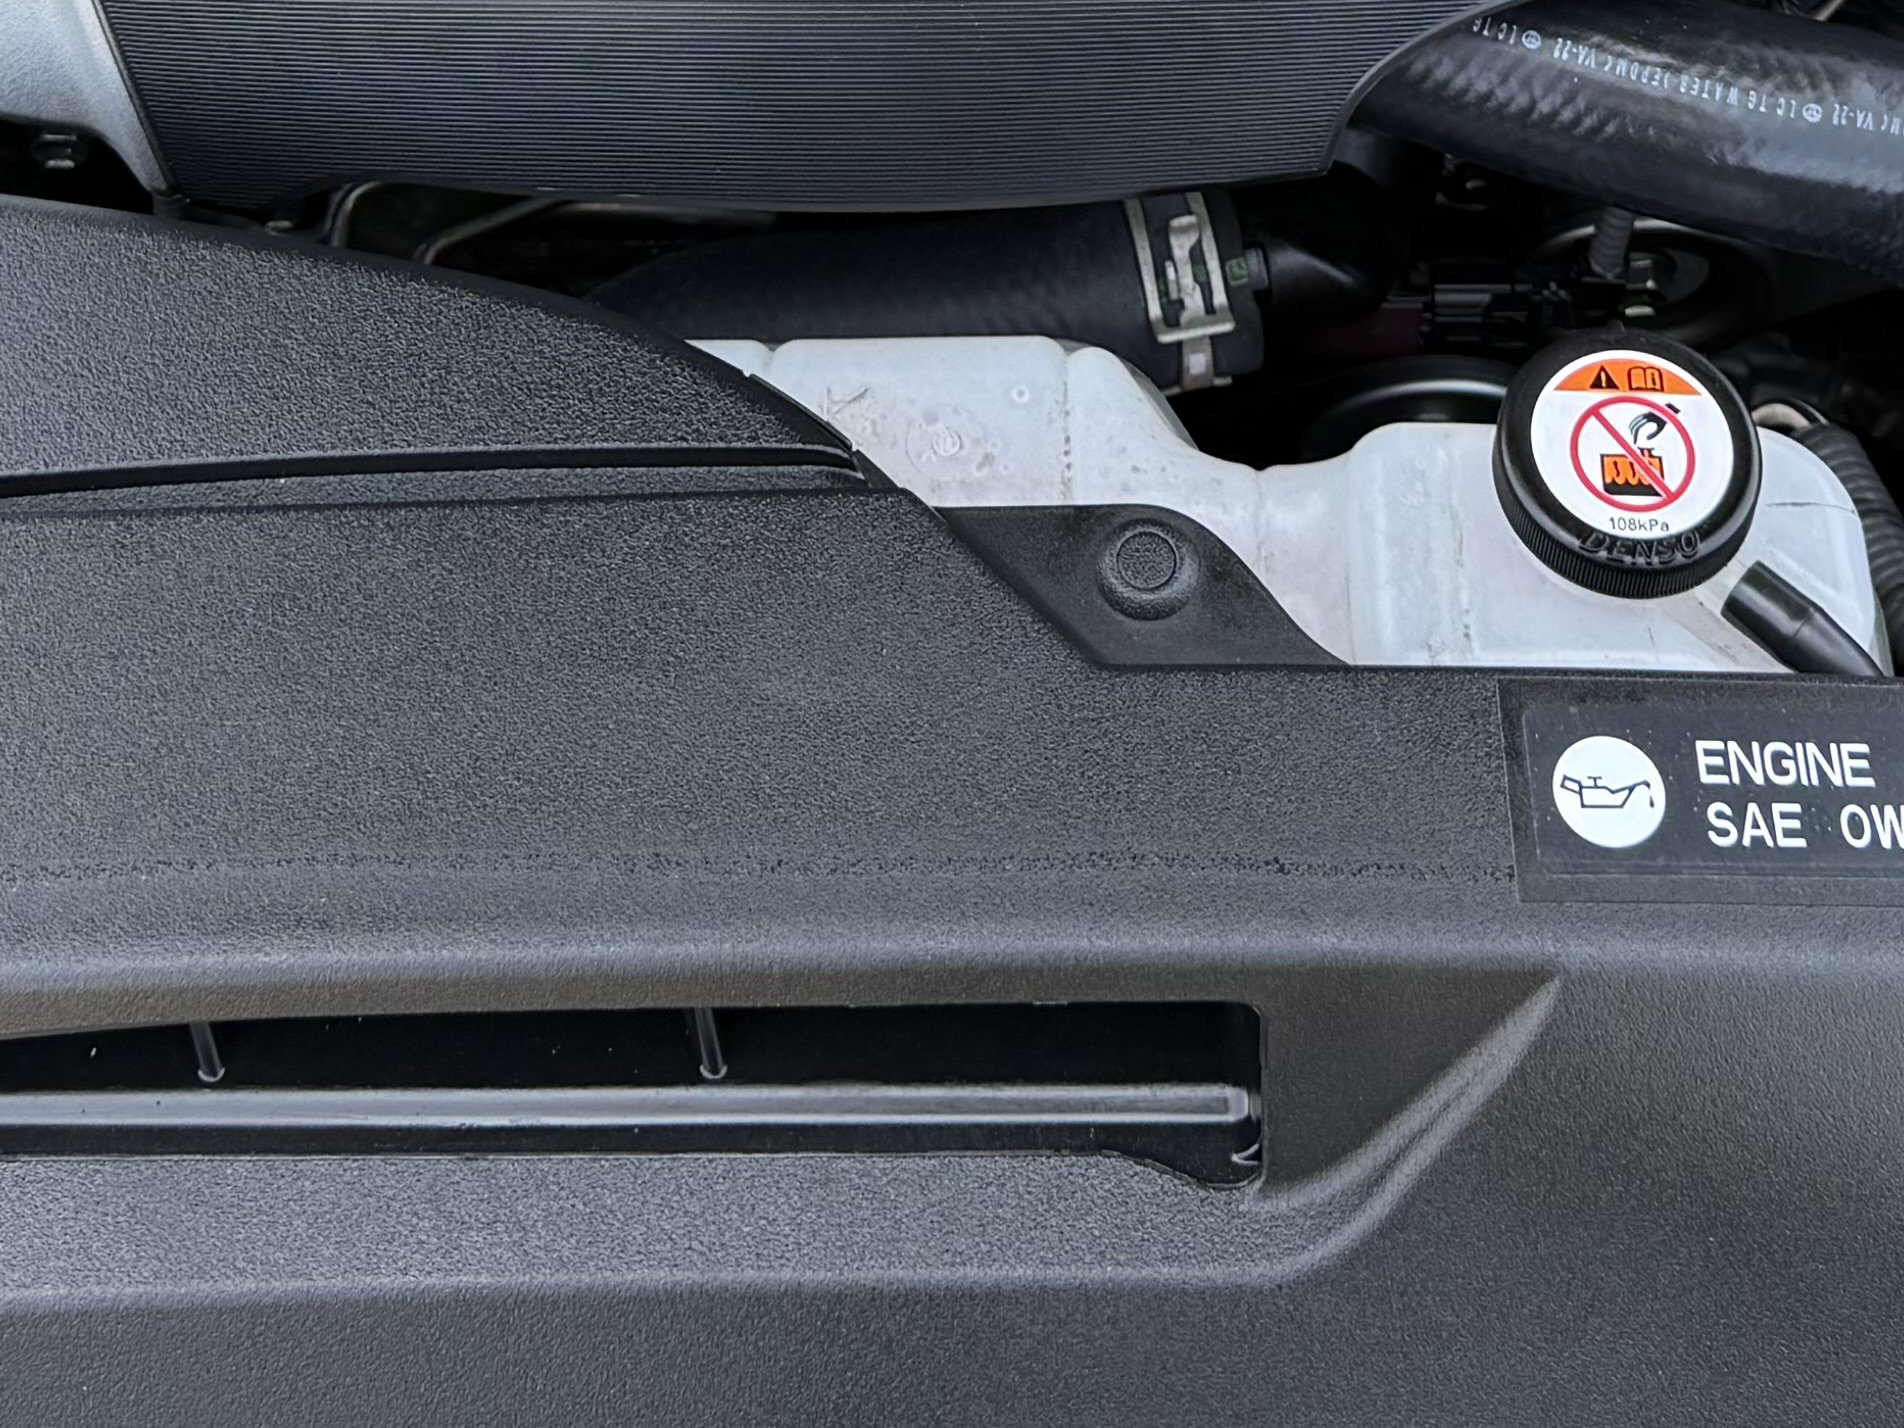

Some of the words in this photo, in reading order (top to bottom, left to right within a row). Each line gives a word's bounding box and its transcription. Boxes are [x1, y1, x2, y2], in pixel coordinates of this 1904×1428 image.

[1680, 75, 1740, 106] WATER
[1831, 104, 1875, 131] VA-22
[1608, 516, 1671, 532] 108kPa
[1576, 530, 1701, 565] DENSO
[1695, 740, 1876, 787] ENGINE
[1707, 801, 1808, 848] SAE
